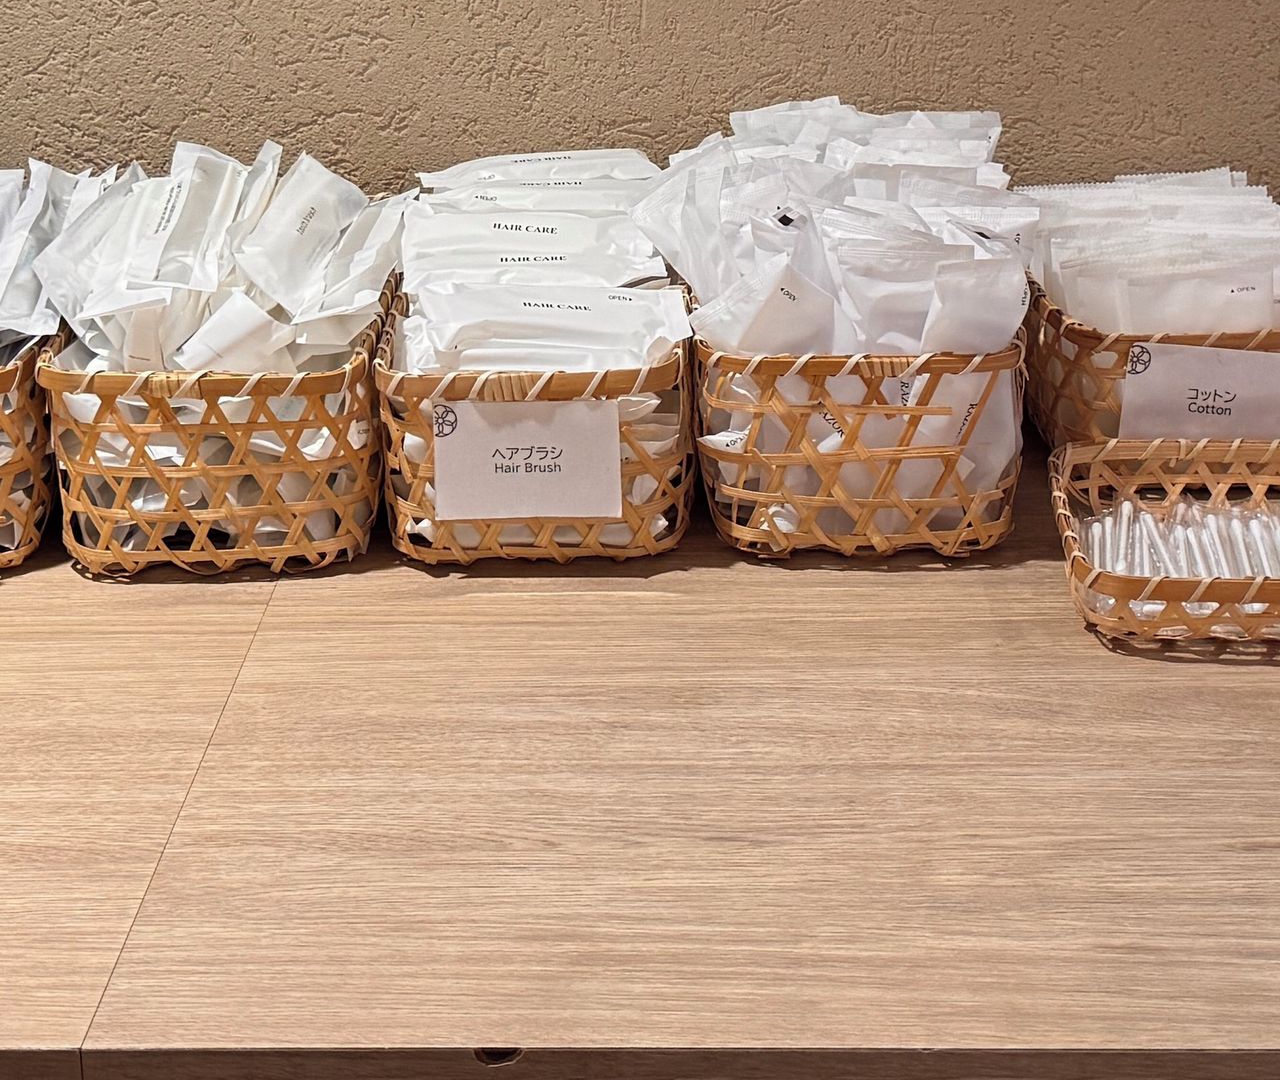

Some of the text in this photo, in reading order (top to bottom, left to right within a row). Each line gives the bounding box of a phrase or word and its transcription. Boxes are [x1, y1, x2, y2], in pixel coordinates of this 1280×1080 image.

[493, 222, 558, 235] HAIR CARE
[533, 255, 567, 263] CARE
[522, 301, 592, 312] HAIR CARE
[1186, 388, 1237, 404] コットン
[1187, 402, 1233, 417] Cotton
[492, 445, 563, 461] ヘアブラシ
[494, 462, 562, 474] Hair Brush
